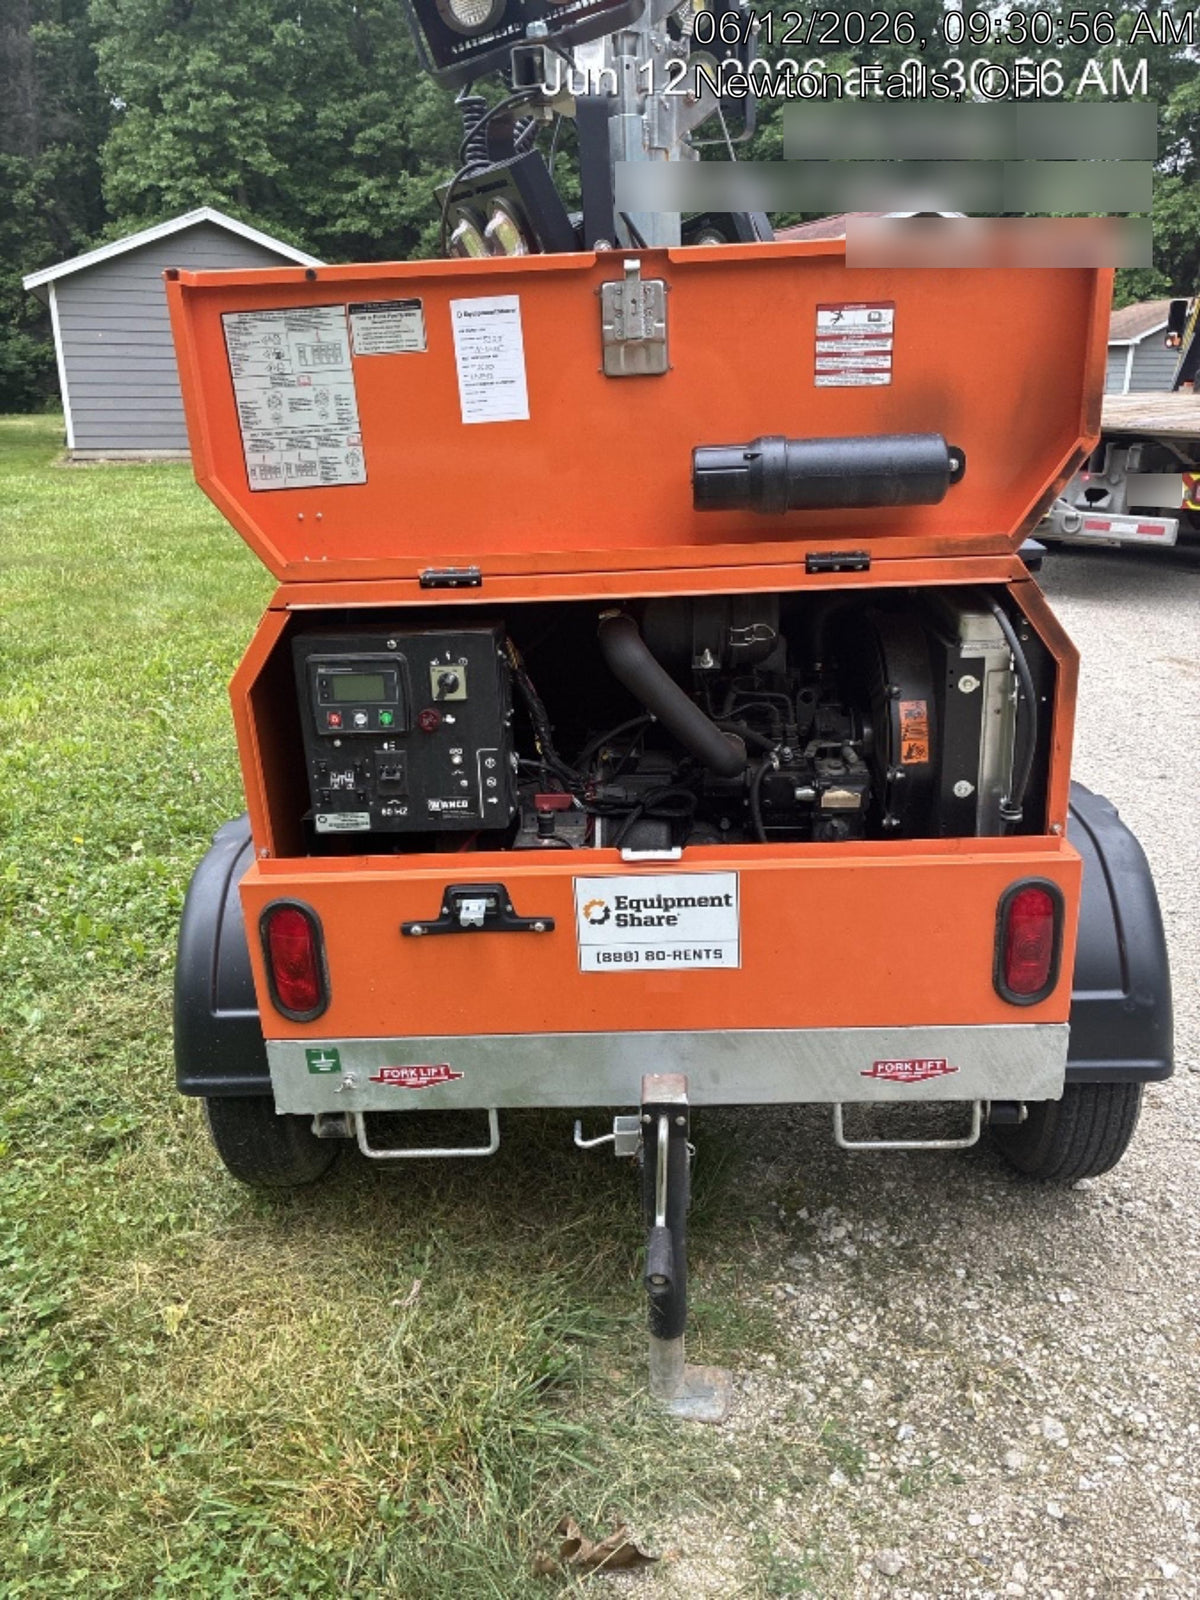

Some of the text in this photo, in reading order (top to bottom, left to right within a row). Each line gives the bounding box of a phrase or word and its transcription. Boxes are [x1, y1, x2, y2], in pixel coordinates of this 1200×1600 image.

[614, 894, 733, 912] Equipment
[615, 913, 678, 928] Share
[596, 949, 723, 964] (888) 80-RENTS
[383, 1066, 446, 1079] FORK LIFT
[877, 1060, 943, 1073] FORK LIFT
